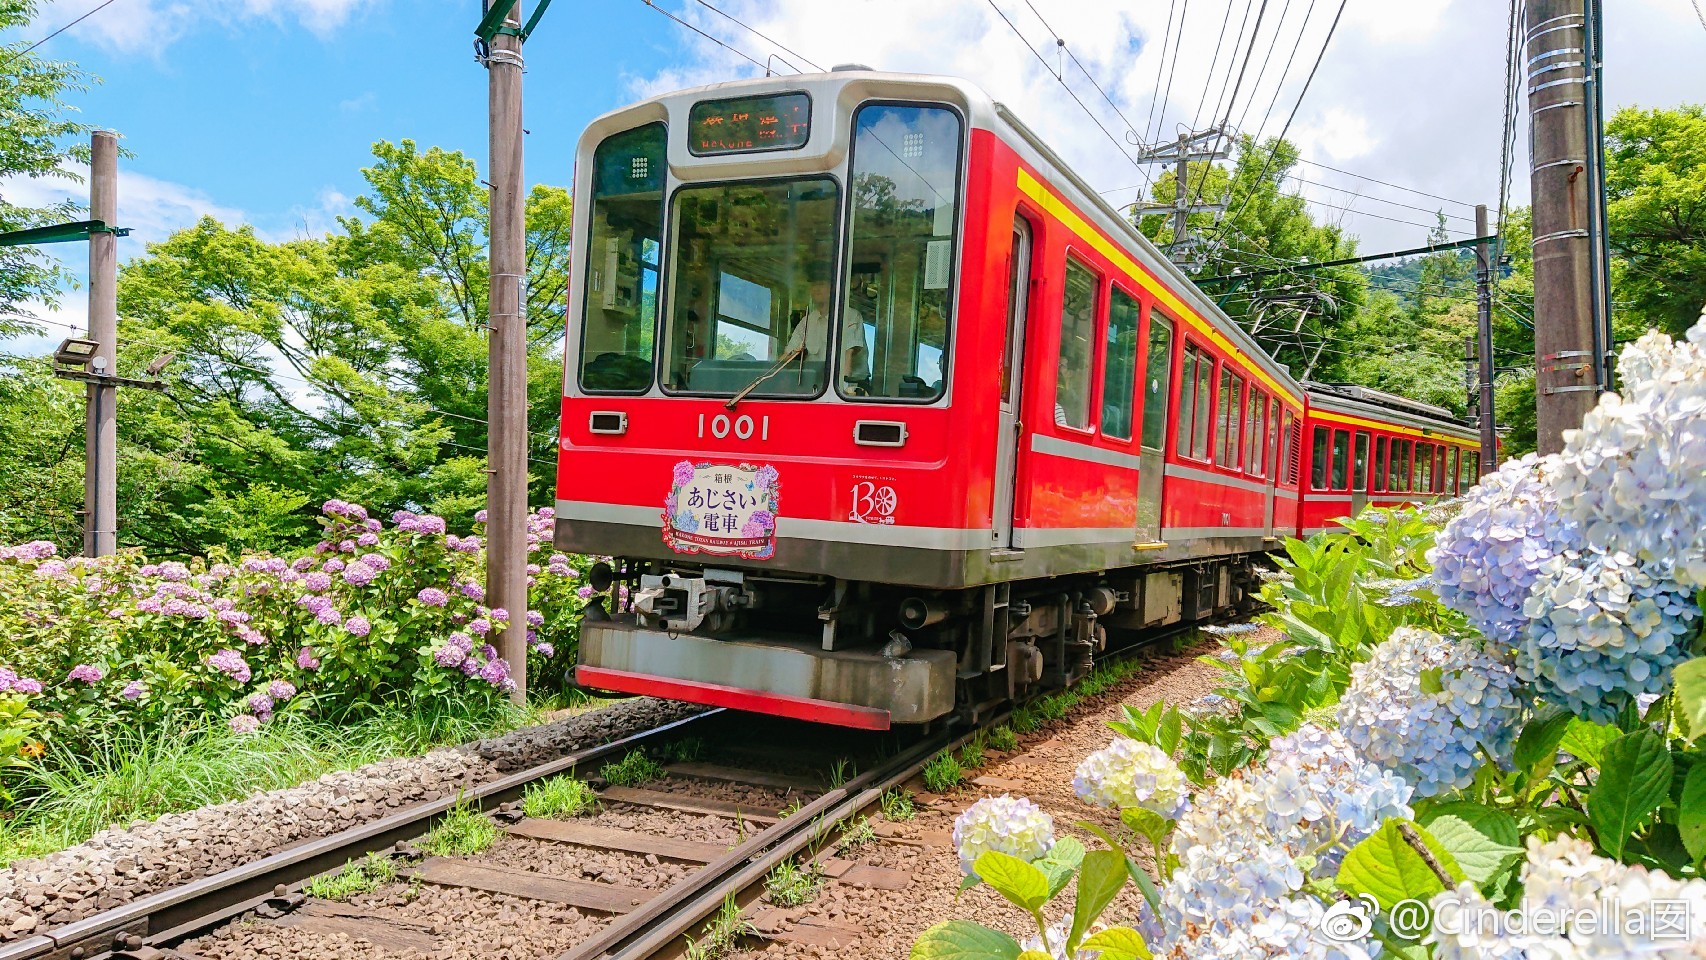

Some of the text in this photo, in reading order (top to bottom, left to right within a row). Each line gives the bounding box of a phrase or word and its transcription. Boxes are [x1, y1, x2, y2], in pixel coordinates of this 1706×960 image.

[698, 413, 769, 440] 1001
[714, 473, 733, 484] 箱根
[687, 486, 757, 511] あじさい
[849, 481, 897, 524] 130
[703, 512, 739, 534] 電車
